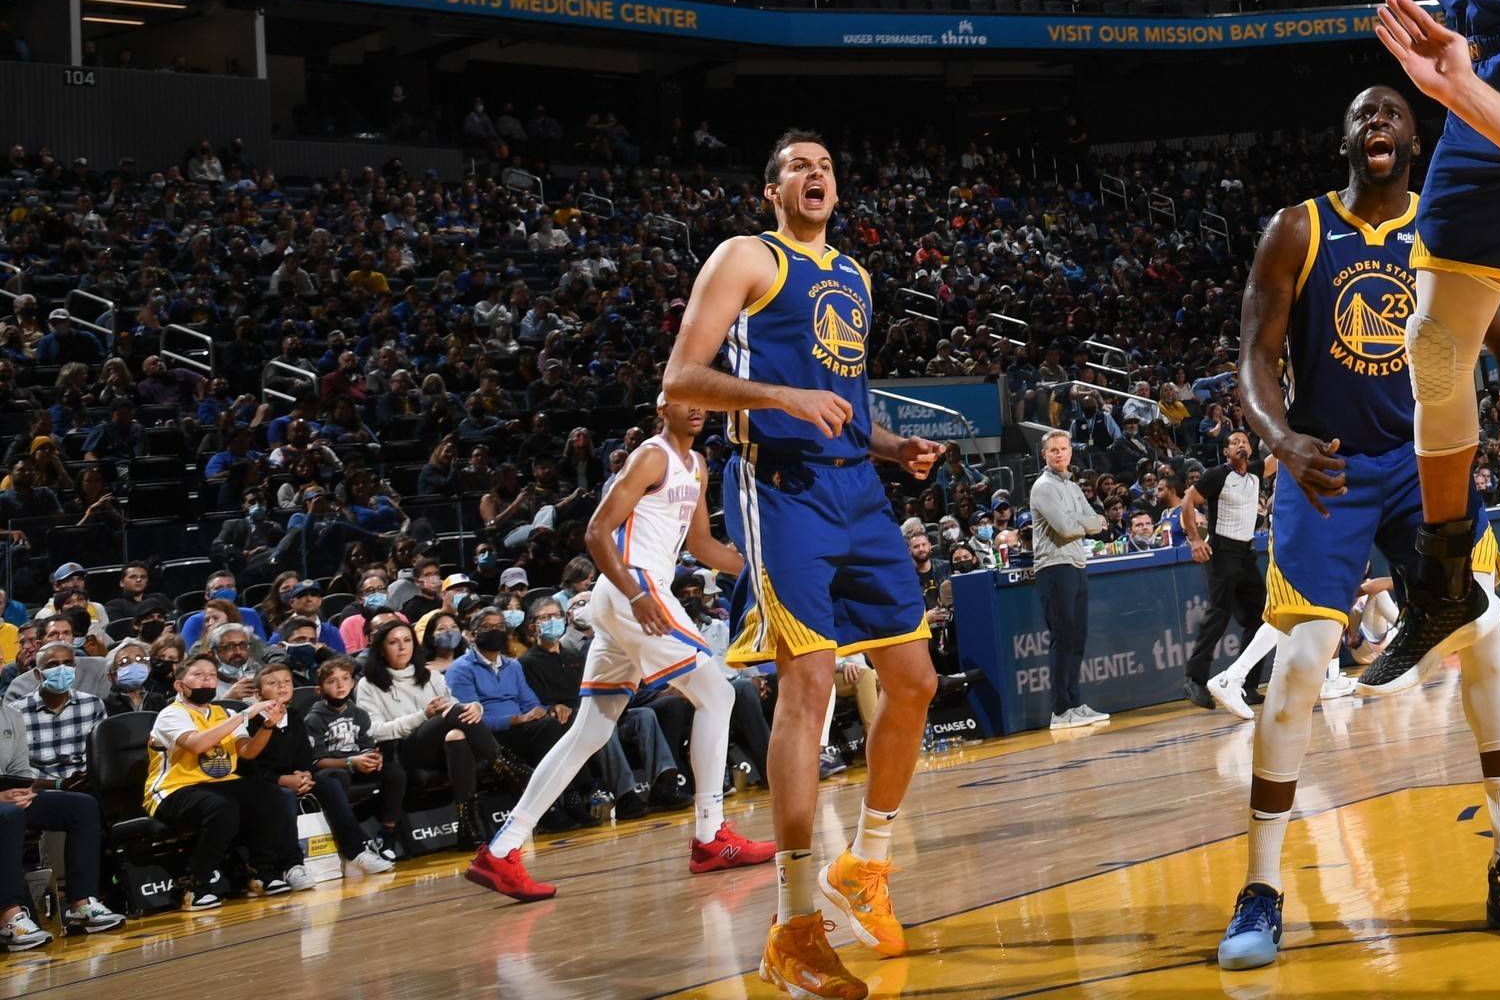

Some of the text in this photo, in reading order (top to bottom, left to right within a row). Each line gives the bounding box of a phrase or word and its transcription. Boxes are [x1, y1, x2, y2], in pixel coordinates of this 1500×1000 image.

[620, 2, 698, 30] CENTER
[843, 33, 873, 44] KAISER
[940, 30, 988, 46] thrive
[1047, 24, 1093, 43] VISIT
[1098, 25, 1140, 43] OUR
[1145, 24, 1224, 44] MISSION
[1230, 22, 1267, 42] BAY
[1273, 17, 1348, 38] SPORTS
[64, 69, 96, 86] 104
[1333, 260, 1381, 288] GOLDEN
[808, 279, 840, 299] GOLDEN
[1381, 293, 1409, 318] 23
[852, 308, 863, 329] 8
[811, 344, 866, 378] WARRIO
[1329, 340, 1409, 377] WARRIO
[899, 405, 936, 419] KAISER
[1008, 568, 1036, 583] CHAS
[1013, 629, 1240, 671] KAIS thrve
[1016, 650, 1138, 696] PERNENTE
[933, 720, 967, 734] CHASE
